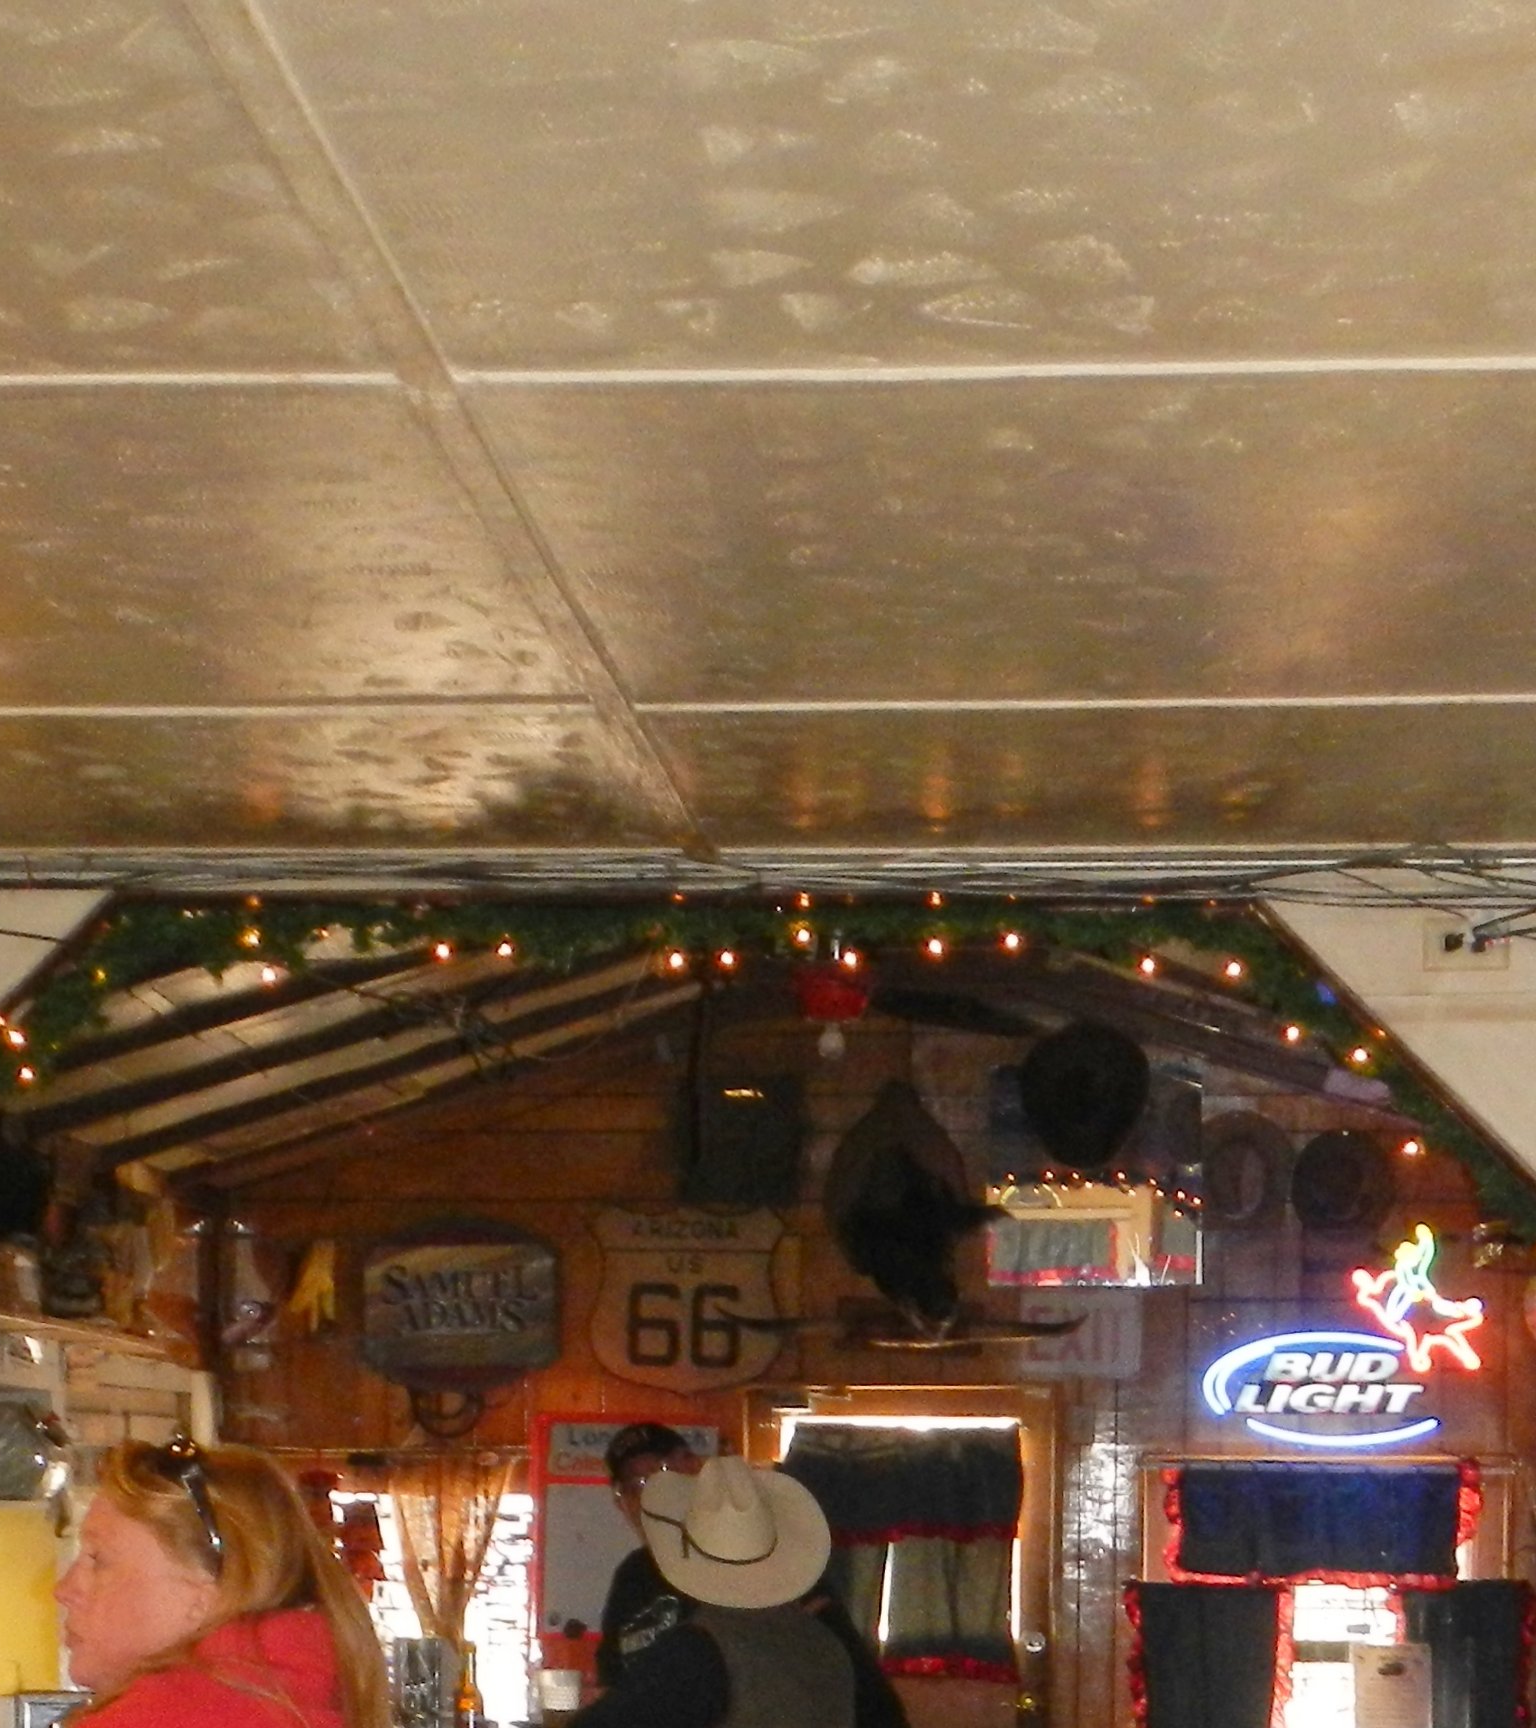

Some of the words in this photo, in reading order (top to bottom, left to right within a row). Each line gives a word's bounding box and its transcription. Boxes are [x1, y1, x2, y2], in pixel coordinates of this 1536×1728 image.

[666, 1253, 704, 1274] US
[379, 1264, 540, 1306] SAMUEL
[394, 1299, 527, 1334] ADAMS
[626, 1283, 741, 1369] 66
[1263, 1351, 1400, 1383] BUD
[1233, 1384, 1424, 1414] LIGHT
